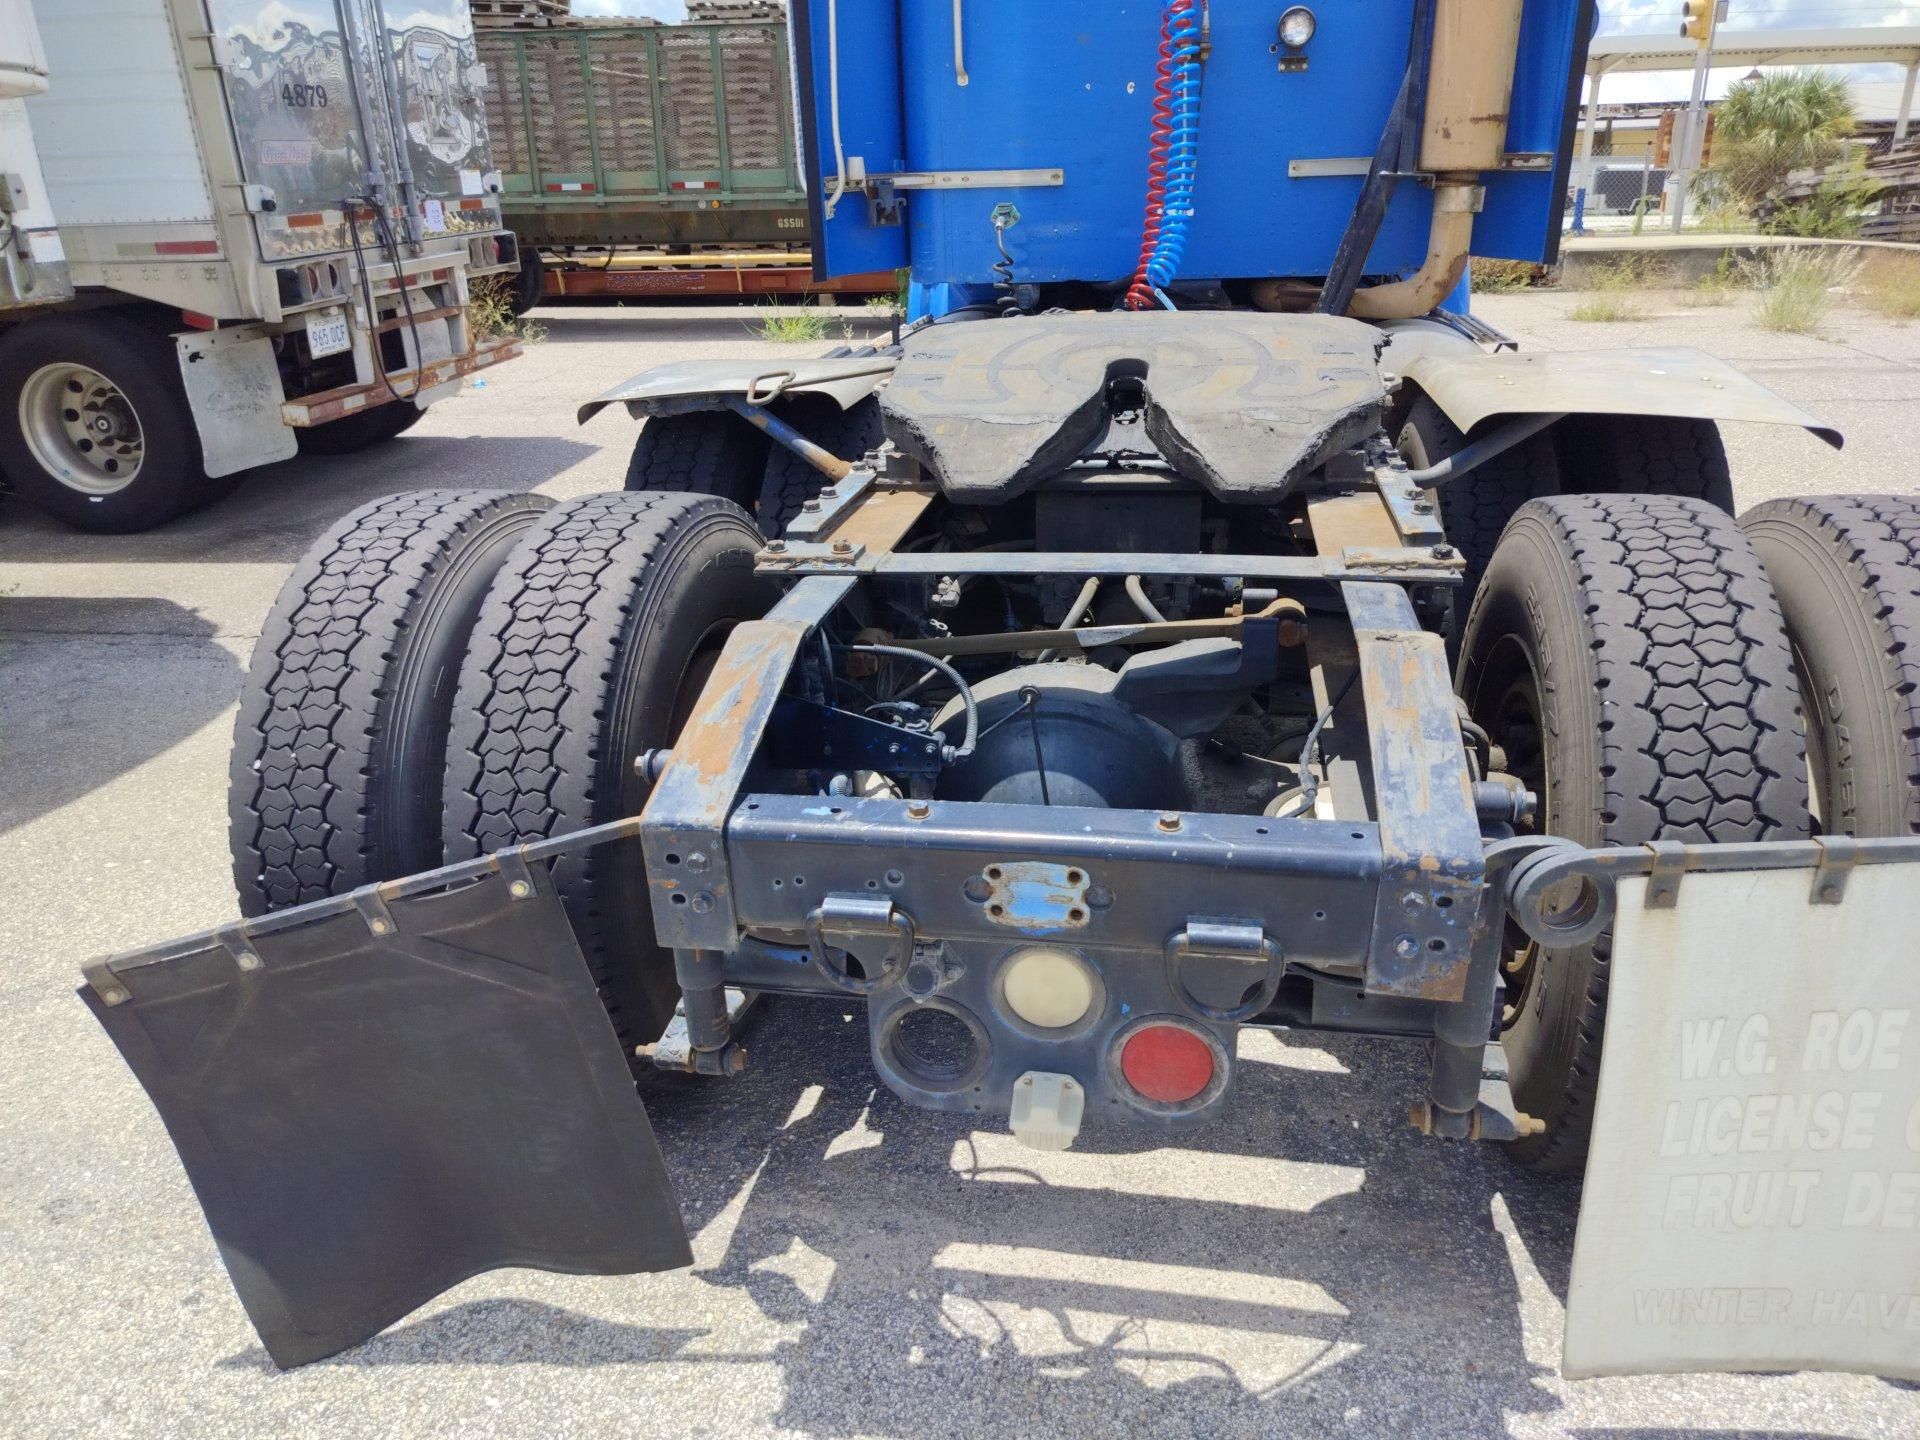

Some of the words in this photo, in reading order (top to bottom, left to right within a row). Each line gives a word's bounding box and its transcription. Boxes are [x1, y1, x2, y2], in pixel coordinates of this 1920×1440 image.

[282, 83, 328, 108] 4879
[312, 328, 329, 347] 965
[1680, 1012, 1778, 1080] W.G.
[1800, 1007, 1911, 1073] ROE
[1660, 1090, 1882, 1156] LICENSE
[1662, 1169, 1822, 1229] FRUIT
[1840, 1170, 1920, 1229] DE
[1632, 1287, 1793, 1327] WINTER
